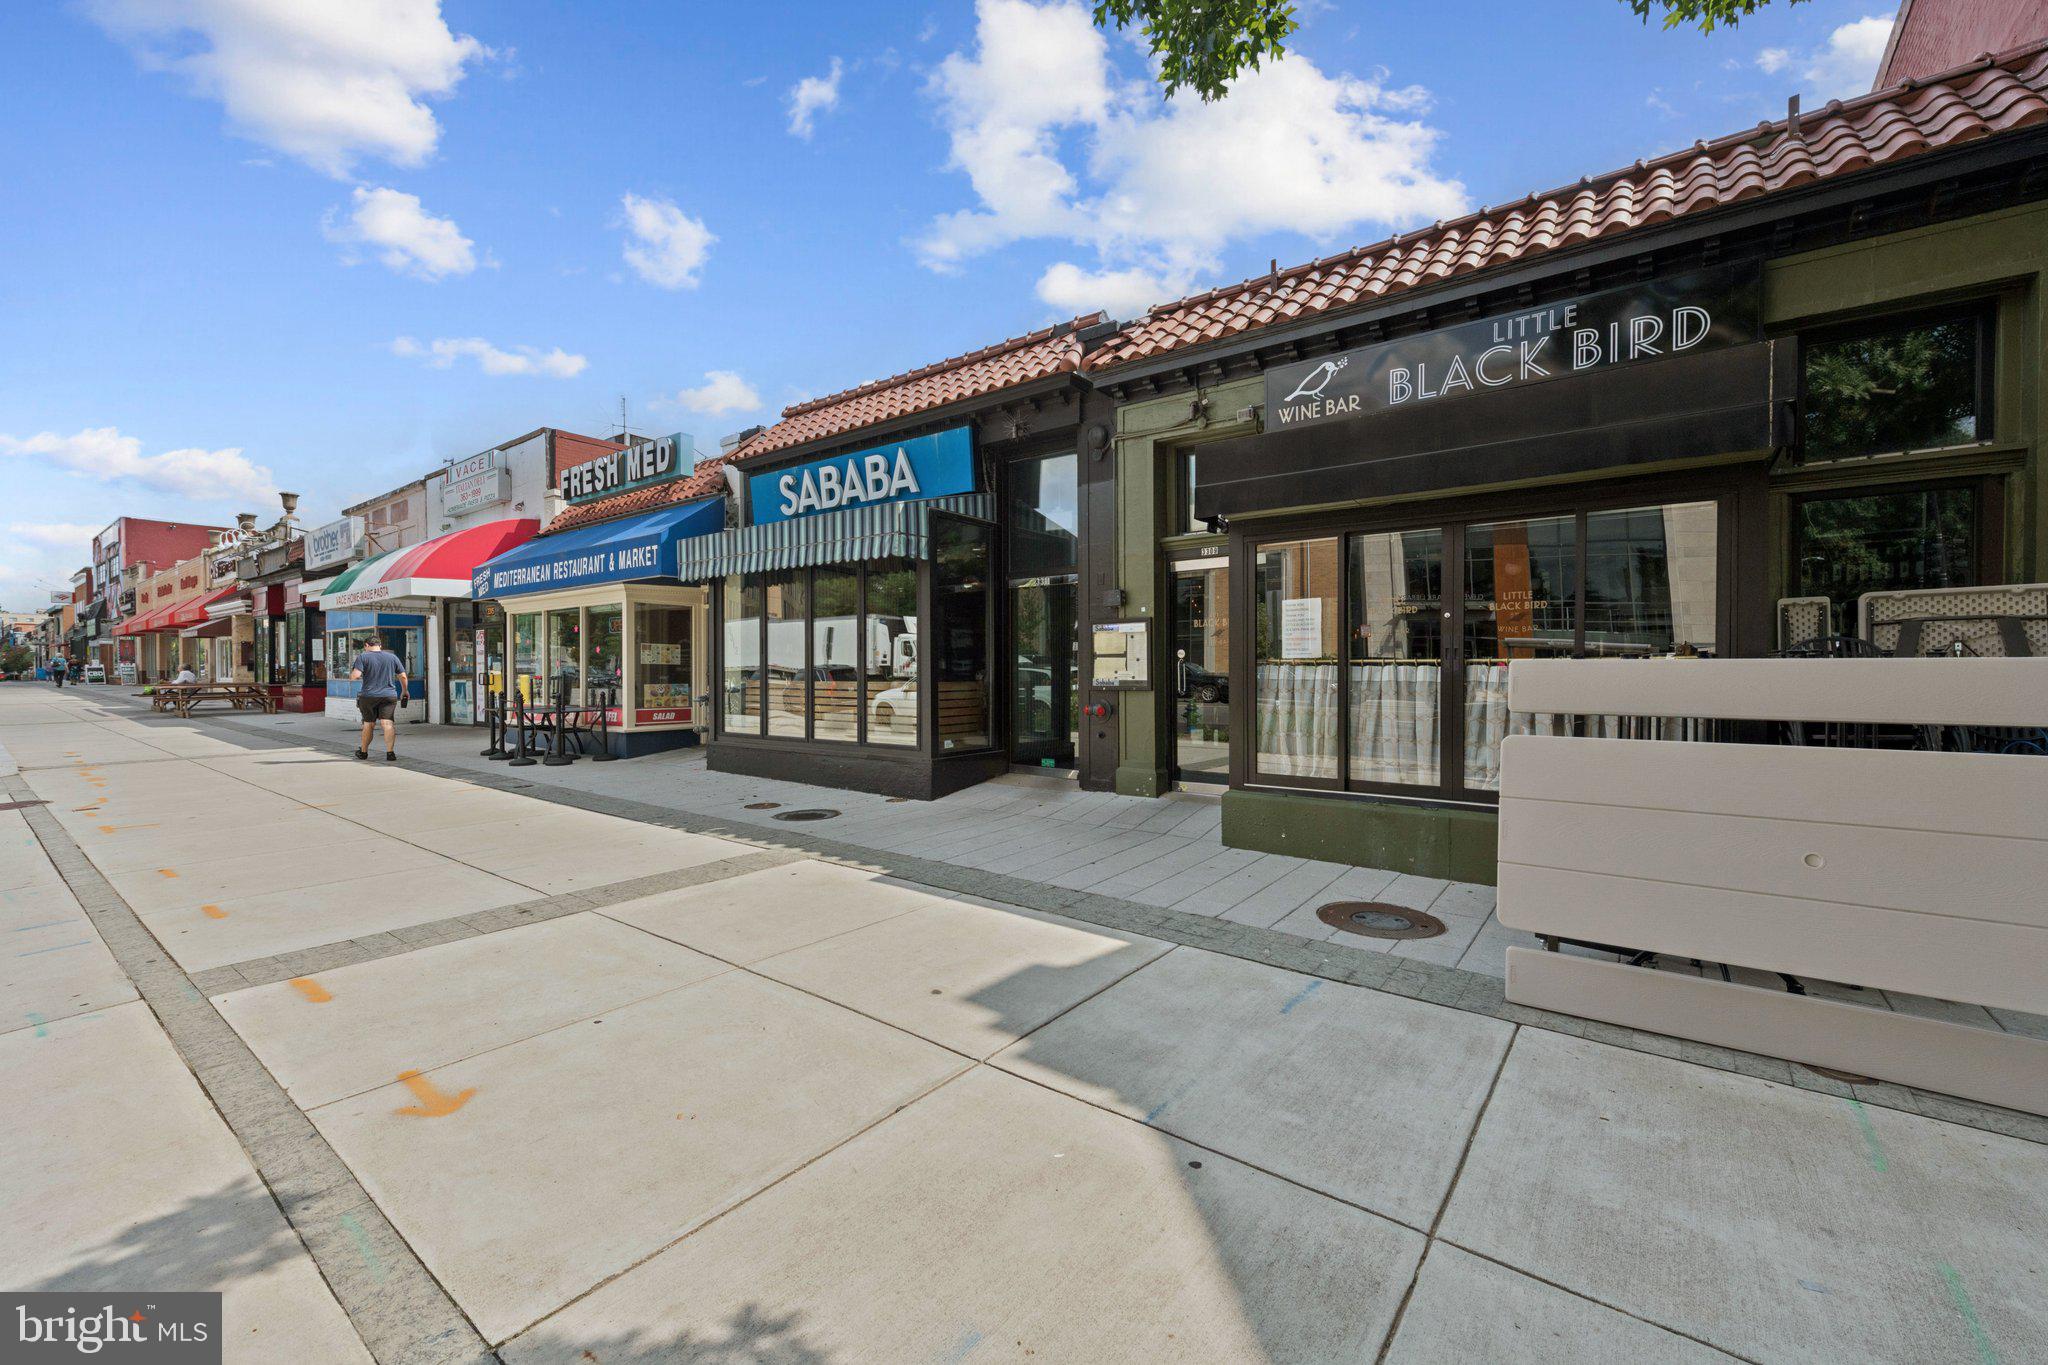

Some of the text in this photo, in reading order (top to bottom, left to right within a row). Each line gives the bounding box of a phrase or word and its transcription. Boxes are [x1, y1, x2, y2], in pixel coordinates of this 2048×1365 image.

[1493, 303, 1578, 343] LITTLE
[1389, 306, 1711, 405] BLACK BIRD
[1278, 394, 1362, 424] WINE BAR
[455, 457, 485, 478] VACE
[560, 437, 672, 500] FRESH MED
[779, 447, 920, 516] SABABA
[493, 544, 659, 589] MEDITERRANEAN RESTAURANT & MARKET
[474, 567, 491, 589] FRESH
[374, 585, 389, 599] PASTA
[477, 581, 489, 598] MED
[1503, 590, 1533, 600] LITTLE
[1489, 600, 1548, 611] BLACK BIRD
[1497, 624, 1540, 633] WINE BAR
[652, 711, 675, 721] SALAD
